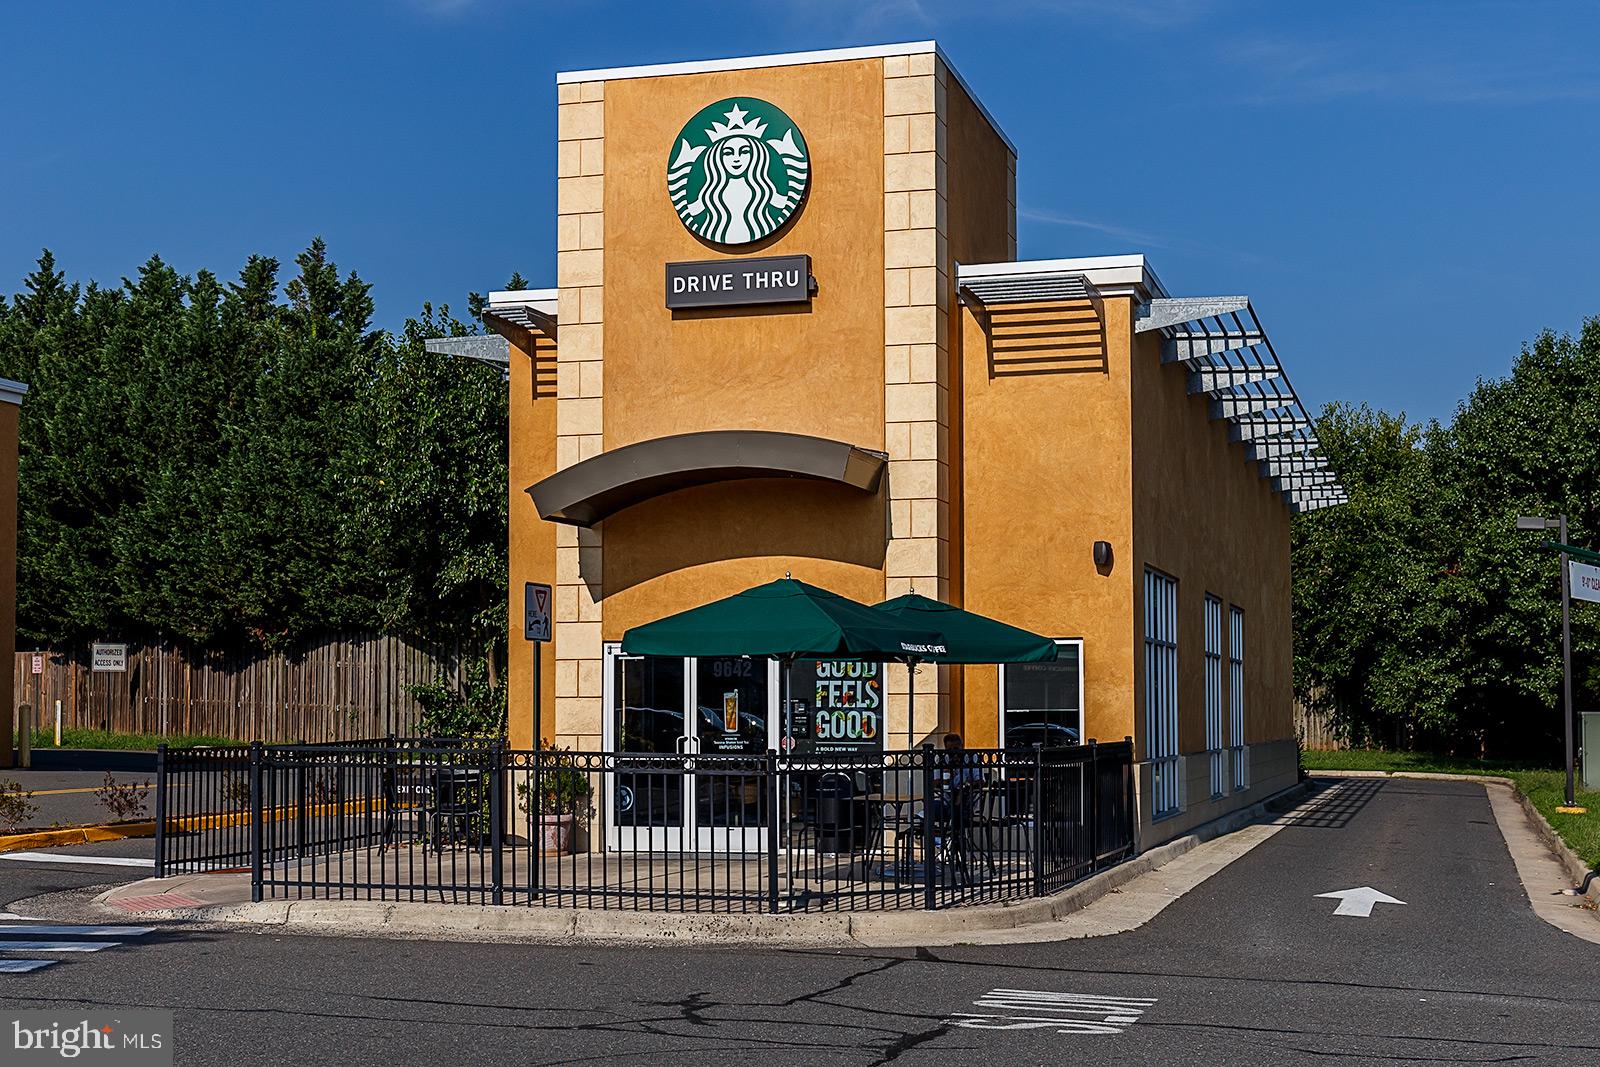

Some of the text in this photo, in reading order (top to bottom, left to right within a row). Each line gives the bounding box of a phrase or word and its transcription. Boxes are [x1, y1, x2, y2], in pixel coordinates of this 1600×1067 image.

[673, 270, 799, 294] DRIVE THRU
[95, 648, 123, 656] AUTHORIZED
[713, 661, 752, 677] 9642
[816, 661, 877, 678] GOOD
[816, 680, 879, 708] FEELS
[816, 710, 877, 739] GOOD
[940, 988, 1159, 1035] SLOW
